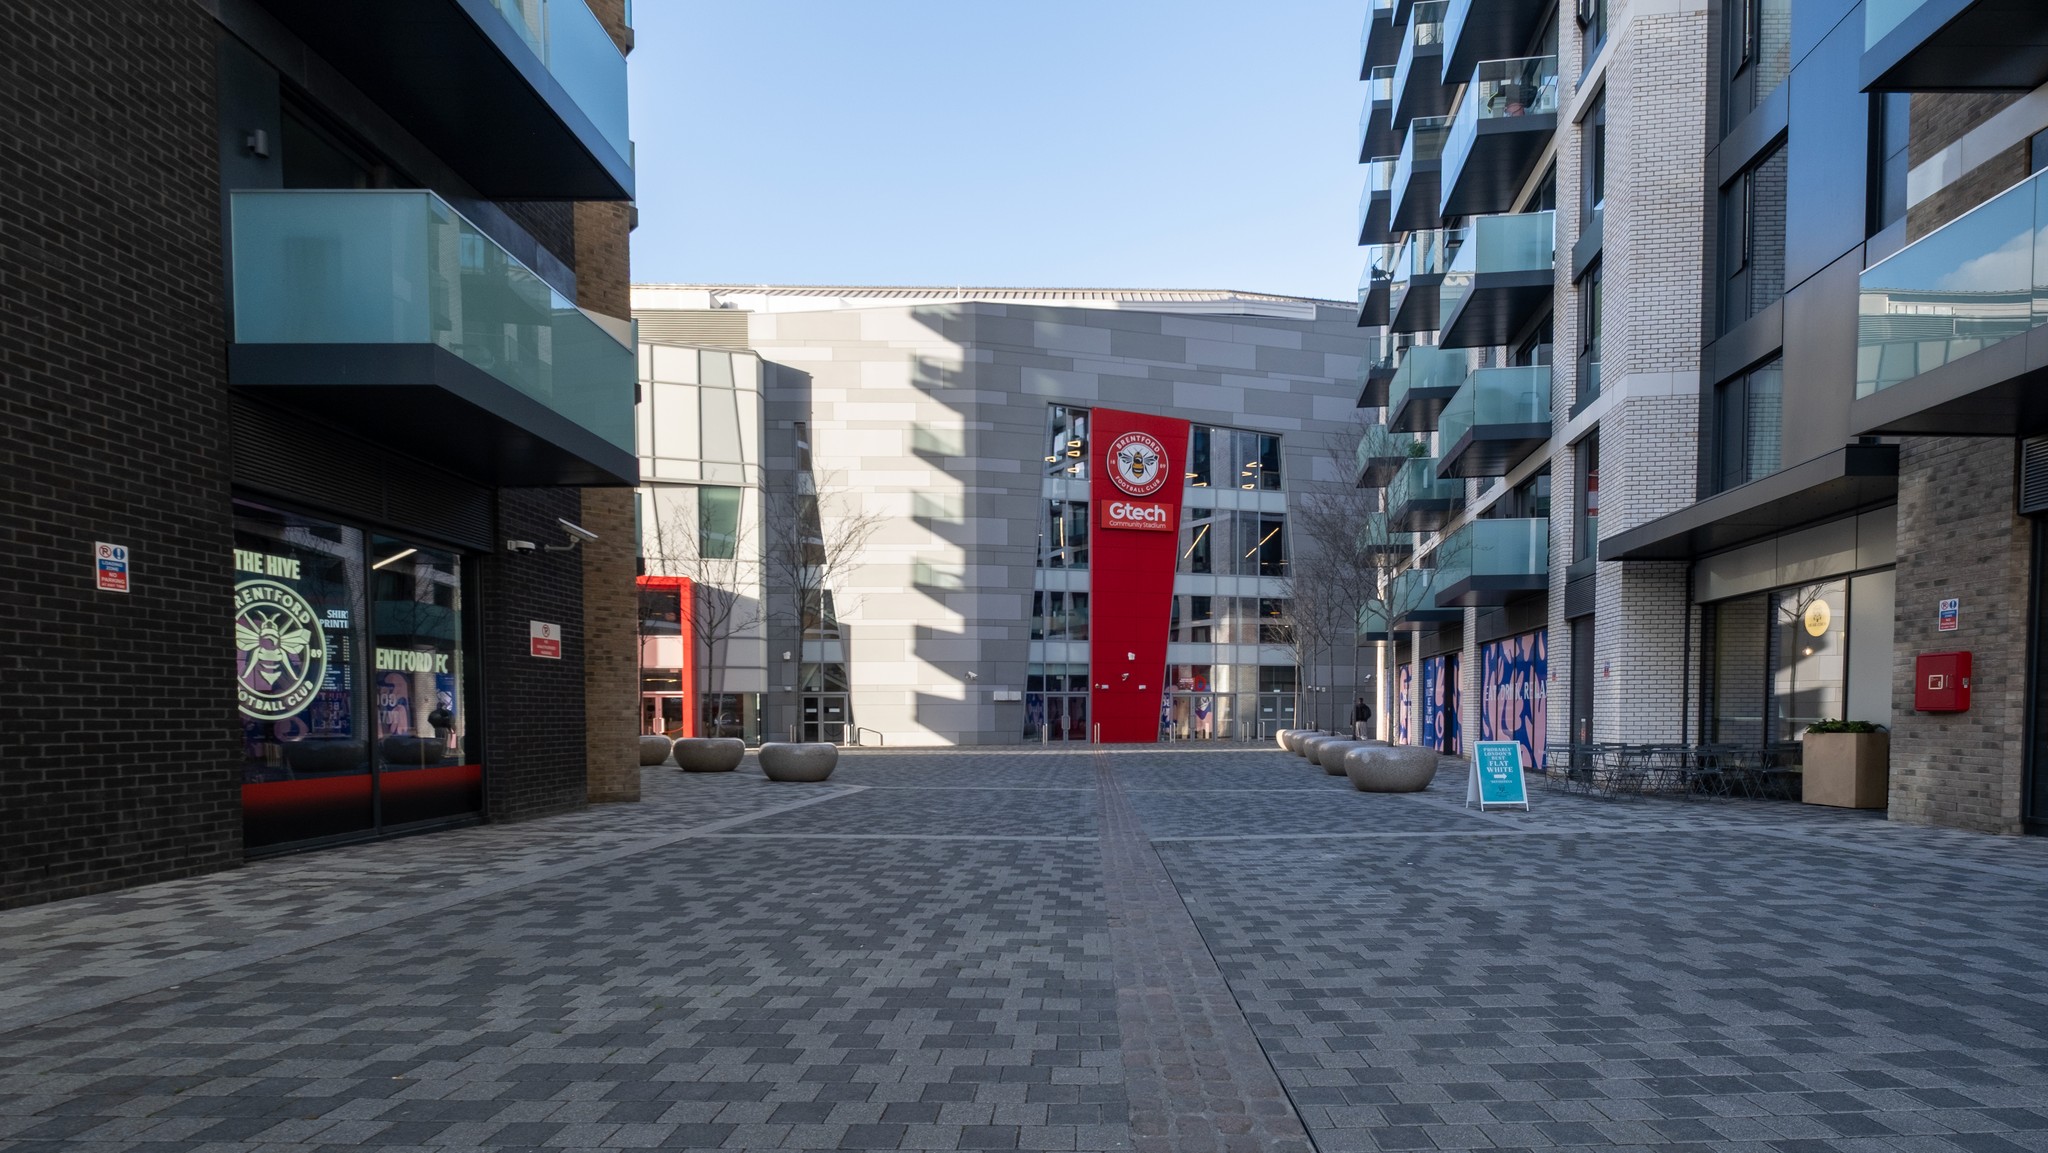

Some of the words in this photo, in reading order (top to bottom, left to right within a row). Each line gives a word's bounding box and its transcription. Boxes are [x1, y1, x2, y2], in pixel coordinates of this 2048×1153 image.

[1116, 436, 1160, 452] BRENTFORD
[1115, 476, 1145, 492] FOOTBALL
[1146, 478, 1160, 492] CLUB
[1110, 502, 1166, 522] Gtech
[1109, 520, 1142, 528] Community
[233, 549, 264, 574] THE
[266, 554, 300, 580] HIVE
[311, 649, 322, 658] 89
[436, 654, 448, 674] FC
[288, 680, 314, 706] CLUB
[1524, 680, 1547, 700] RELA
